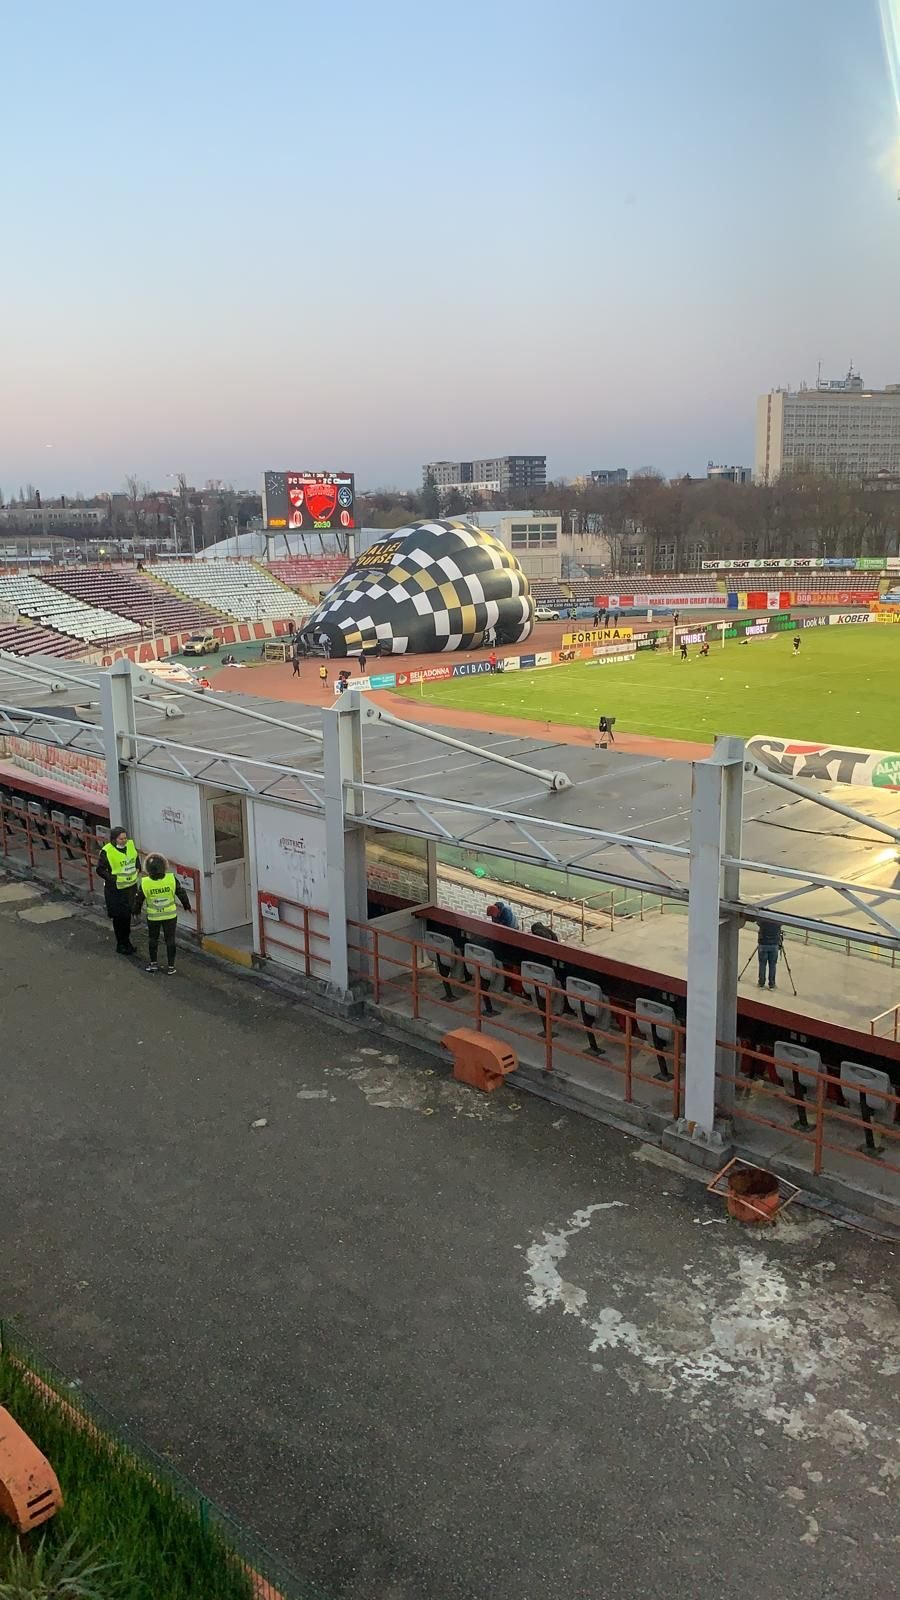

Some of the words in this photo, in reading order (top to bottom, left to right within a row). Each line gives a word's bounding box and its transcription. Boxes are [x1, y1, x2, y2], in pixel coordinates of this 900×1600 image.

[838, 614, 870, 624] KOBER
[746, 624, 768, 635] UNIBET
[681, 632, 706, 644] UNIBET
[599, 654, 636, 664] UNIBET
[410, 668, 450, 678] BELLADONNA
[453, 660, 504, 676] ACIBADM
